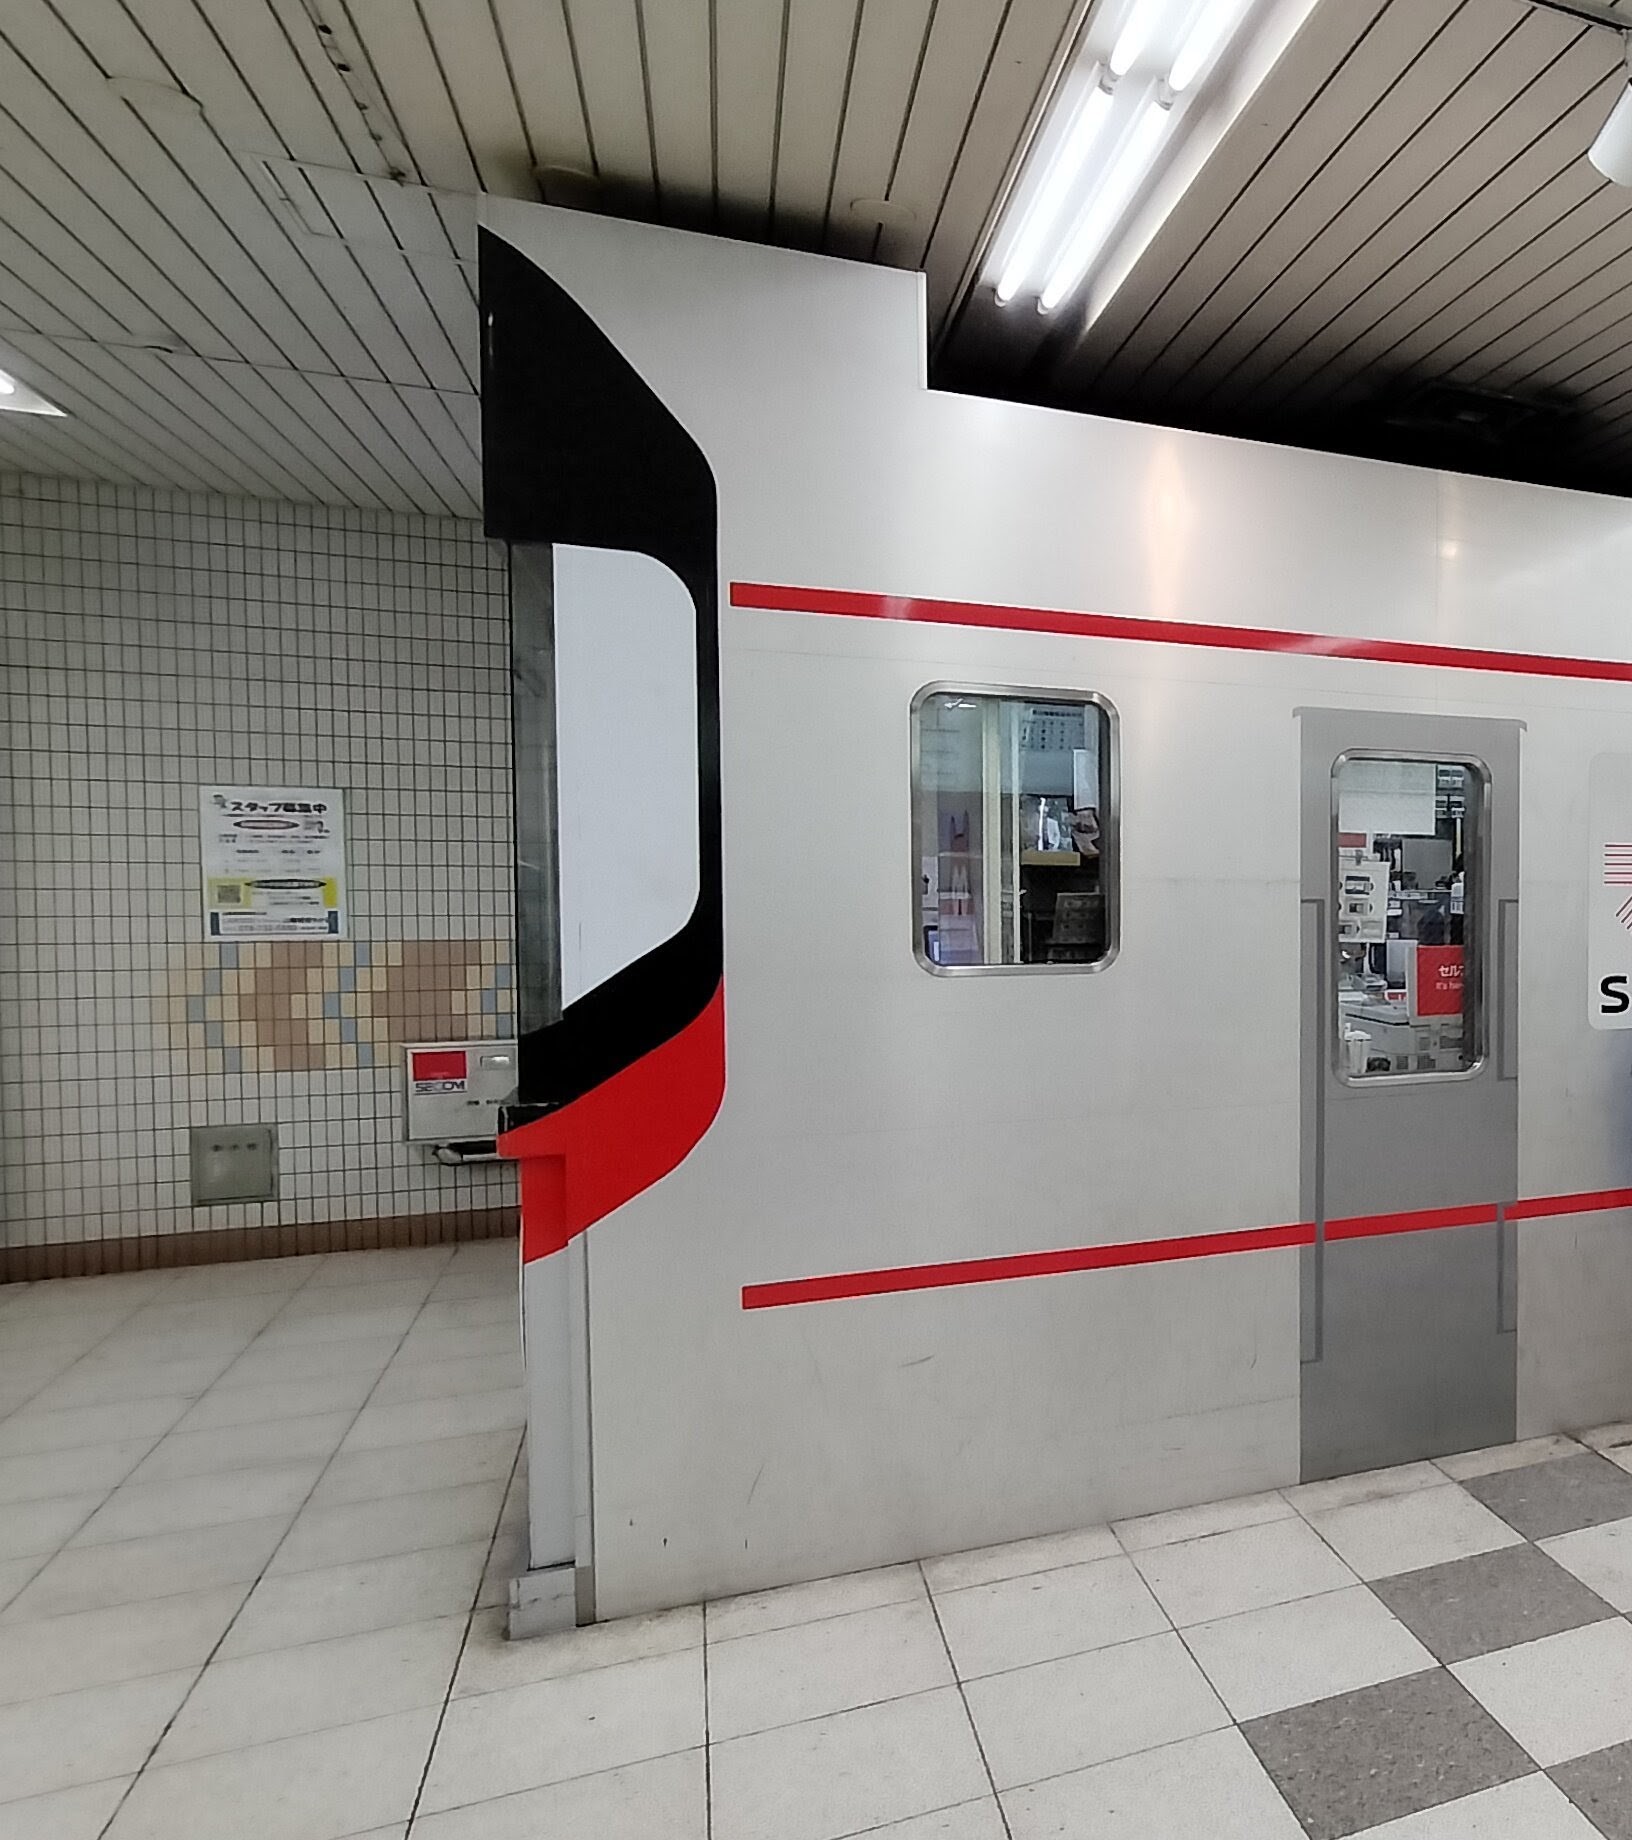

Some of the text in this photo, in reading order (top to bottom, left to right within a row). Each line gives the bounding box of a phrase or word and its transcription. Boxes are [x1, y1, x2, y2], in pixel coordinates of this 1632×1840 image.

[229, 801, 328, 814] スタッフ募集中
[415, 1080, 465, 1093] SECOM
